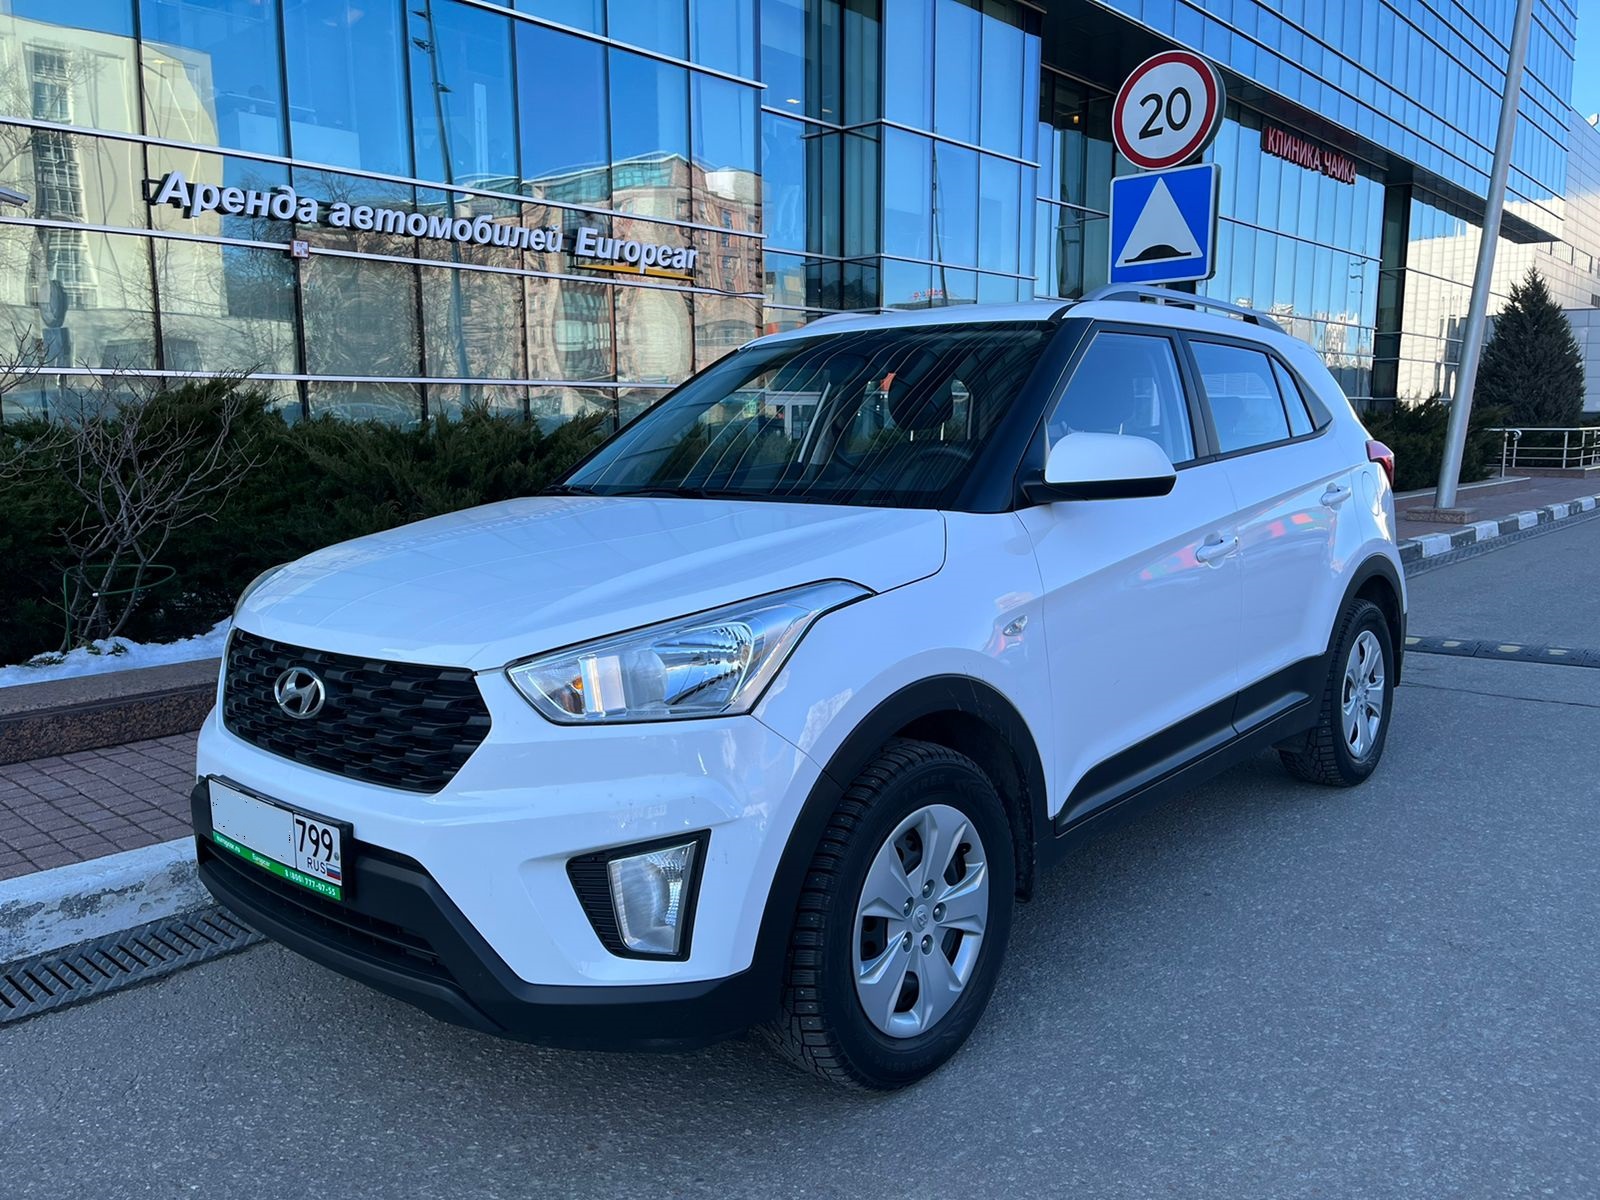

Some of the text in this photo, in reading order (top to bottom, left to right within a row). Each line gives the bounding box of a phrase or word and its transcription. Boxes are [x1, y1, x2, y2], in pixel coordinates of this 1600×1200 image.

[1139, 86, 1192, 140] 20
[1267, 126, 1357, 182] КЛИНИКА ЧАЙКА
[155, 170, 699, 274] Аренда автомобилей Europcar
[295, 818, 333, 862] 799
[307, 856, 326, 875] RUS
